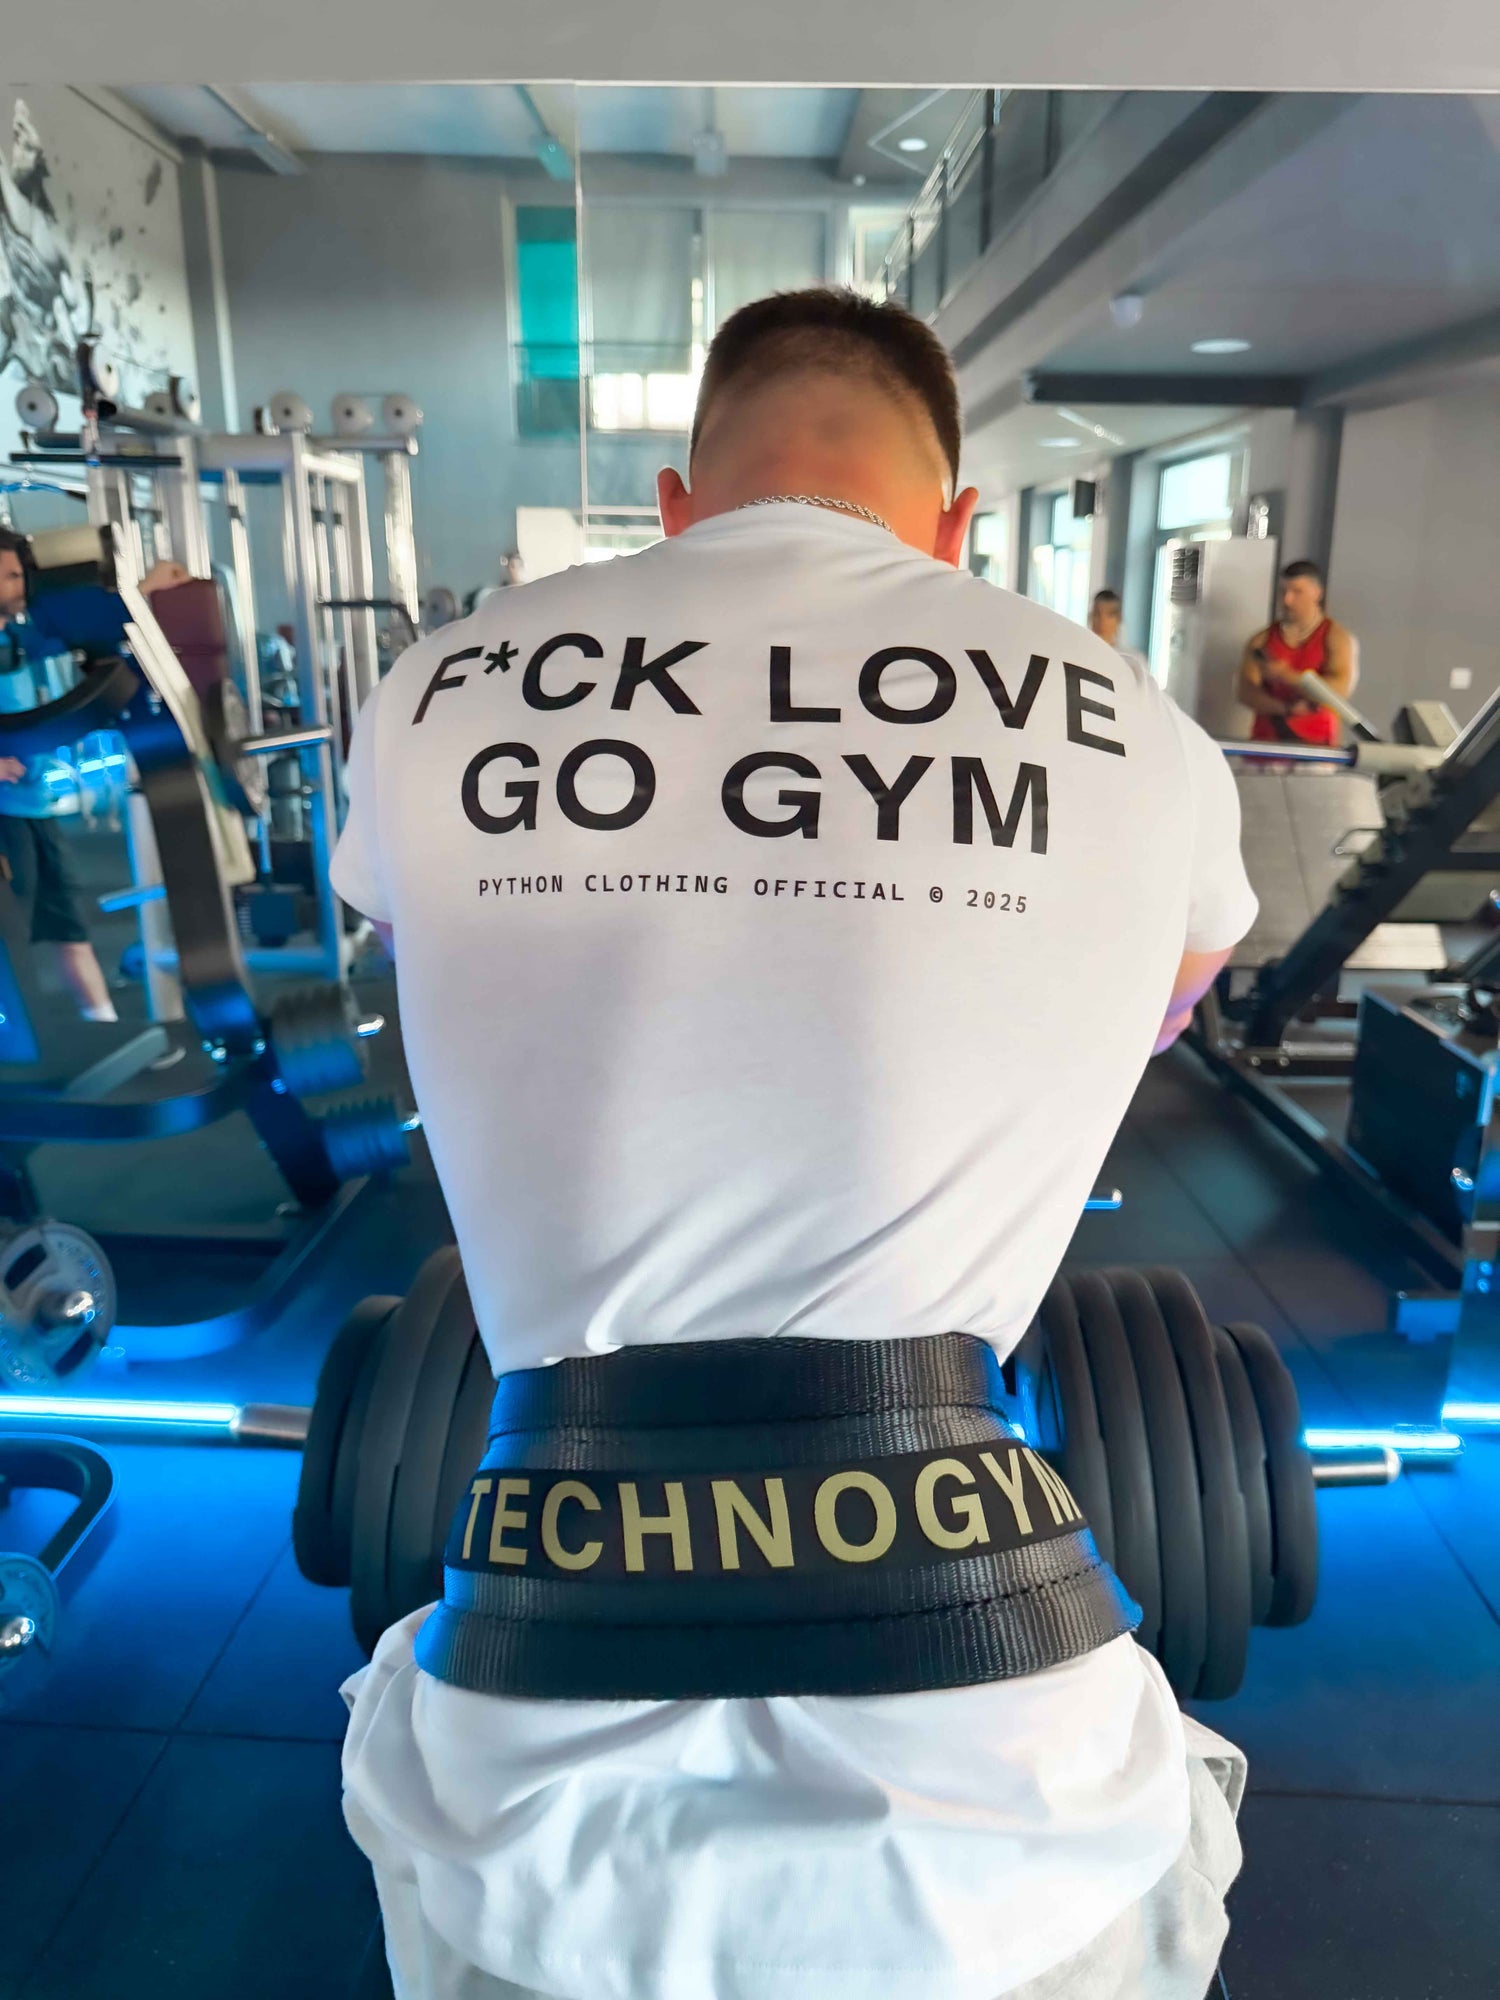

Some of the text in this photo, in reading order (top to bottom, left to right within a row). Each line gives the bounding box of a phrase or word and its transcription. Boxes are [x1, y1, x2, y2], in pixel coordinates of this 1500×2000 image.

[769, 645, 1127, 758] LOVE
[461, 738, 1050, 856] GO GYM
[478, 874, 563, 897] PYTHON
[584, 873, 729, 894] CLOTHING
[753, 878, 905, 901] OFFICIAL
[966, 889, 1028, 914] 2025
[461, 1446, 1084, 1573] TECHNOGYM
